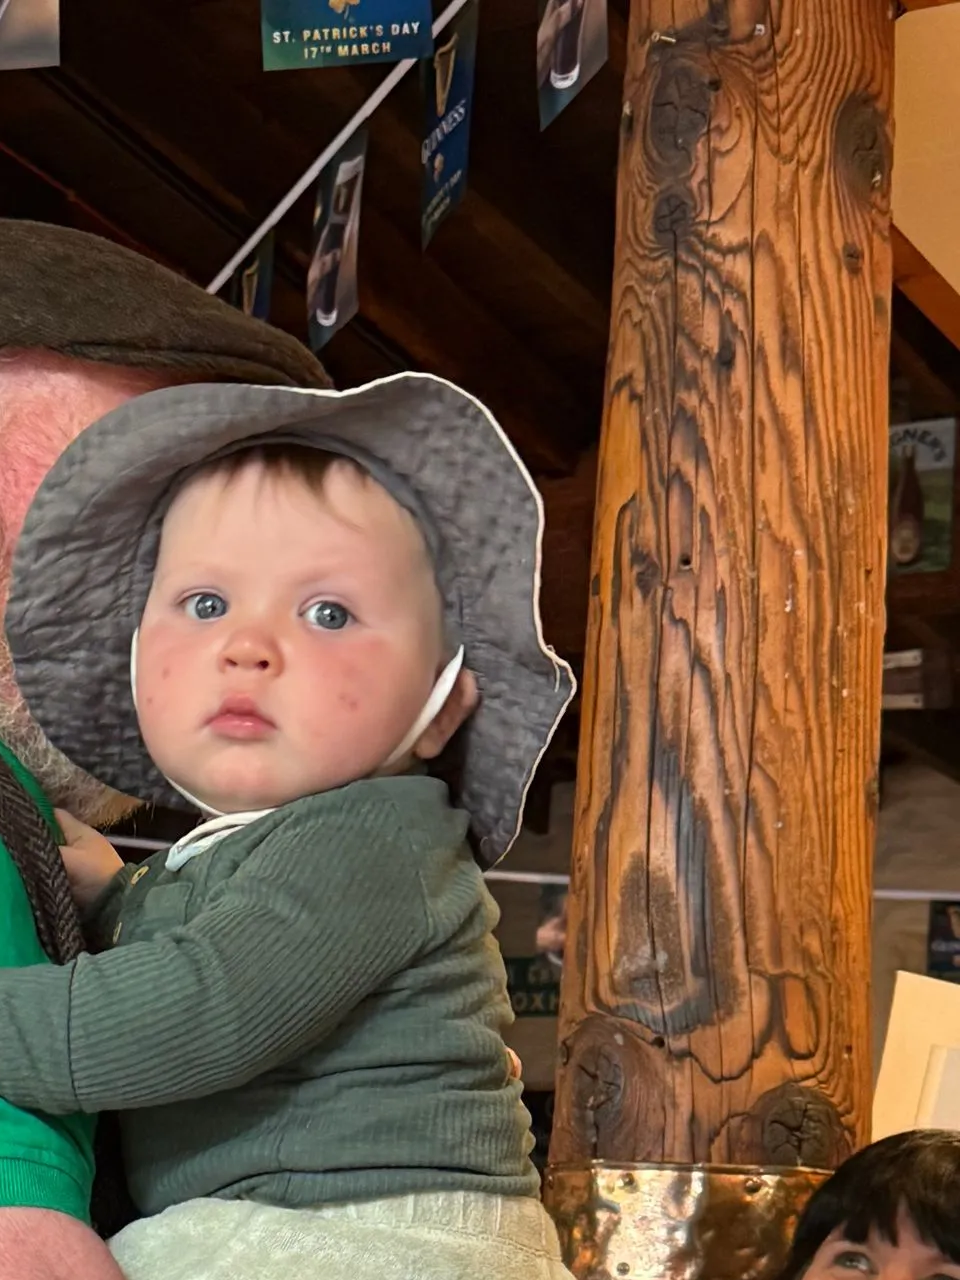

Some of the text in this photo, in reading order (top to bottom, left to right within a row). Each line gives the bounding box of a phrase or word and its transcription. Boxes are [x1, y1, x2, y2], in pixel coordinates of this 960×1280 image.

[272, 22, 421, 44] ST. PATRICK'S DAY
[338, 42, 391, 57] MARCH
